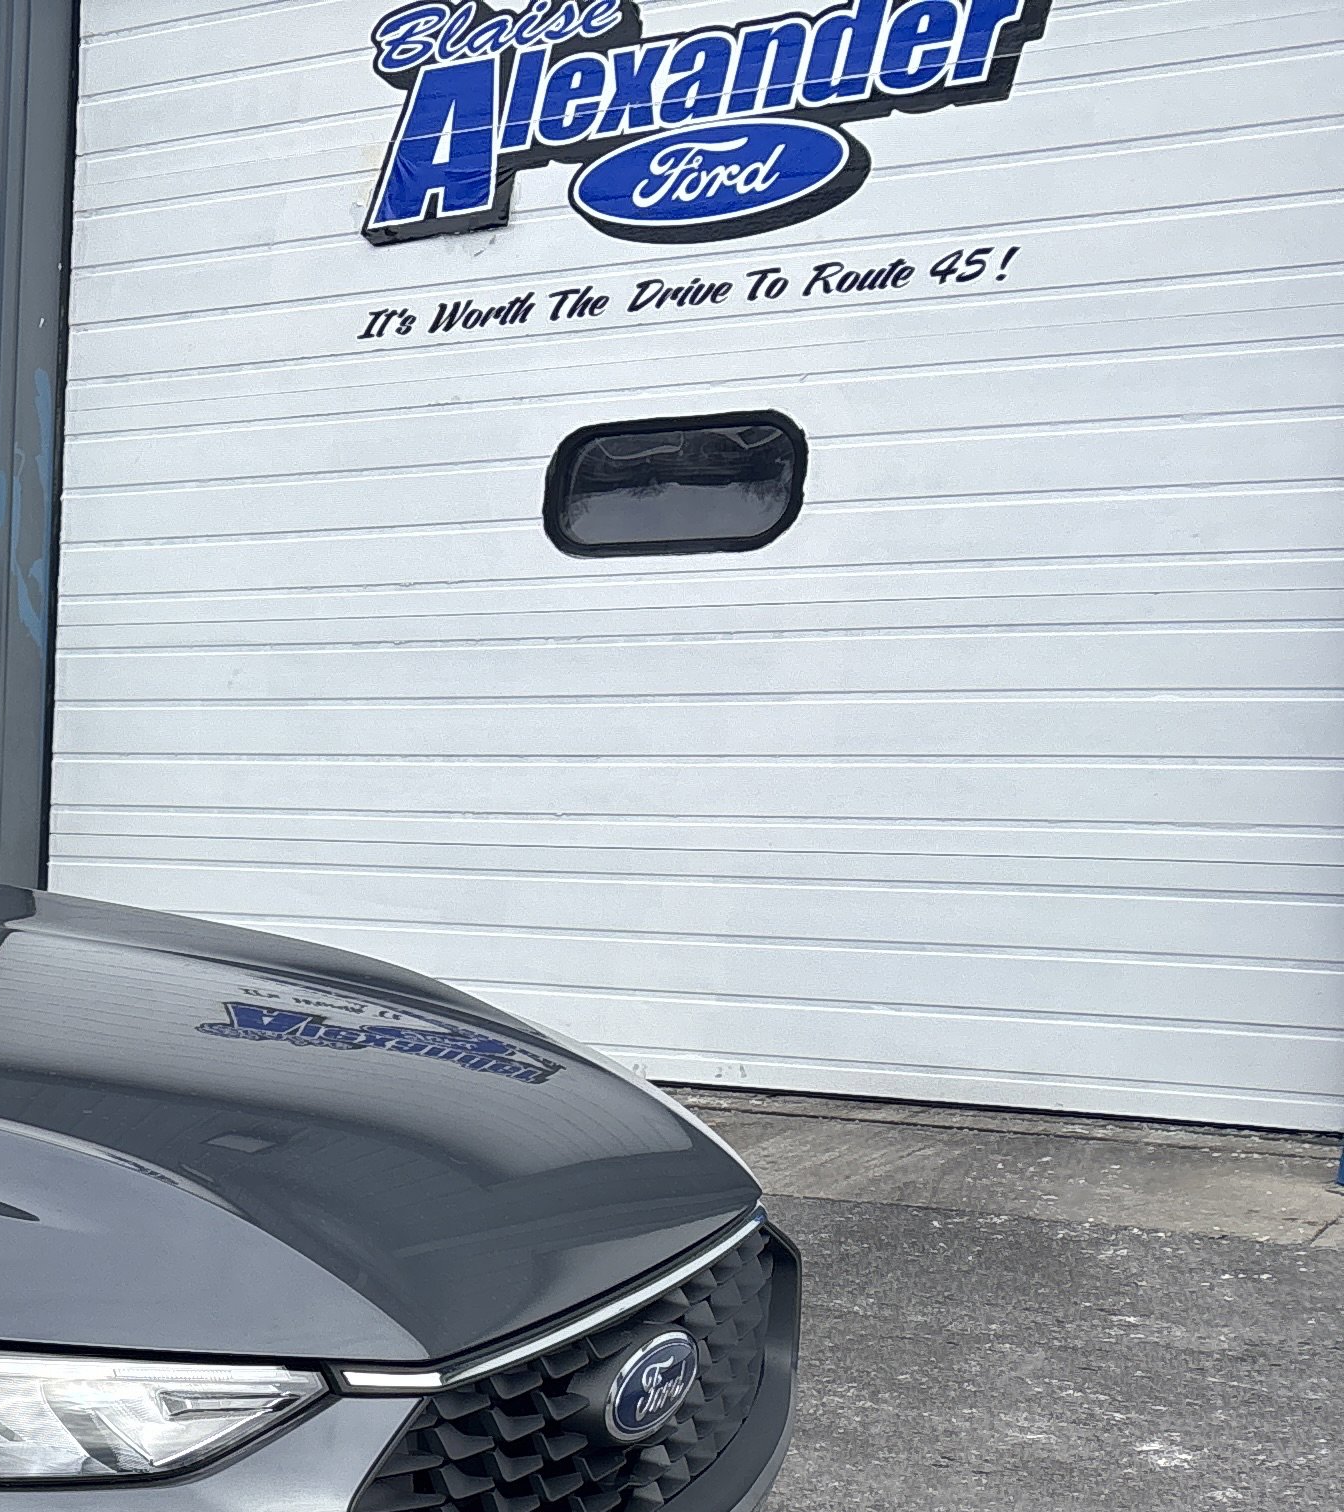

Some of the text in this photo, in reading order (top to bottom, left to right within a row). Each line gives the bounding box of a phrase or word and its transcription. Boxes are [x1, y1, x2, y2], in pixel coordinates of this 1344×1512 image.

[374, 0, 622, 73] Blaise
[366, 0, 1025, 230] Alexander
[632, 136, 787, 208] Ford
[357, 246, 1021, 340] It's Worth The Drive To Route 45!
[635, 1355, 687, 1422] Ford
